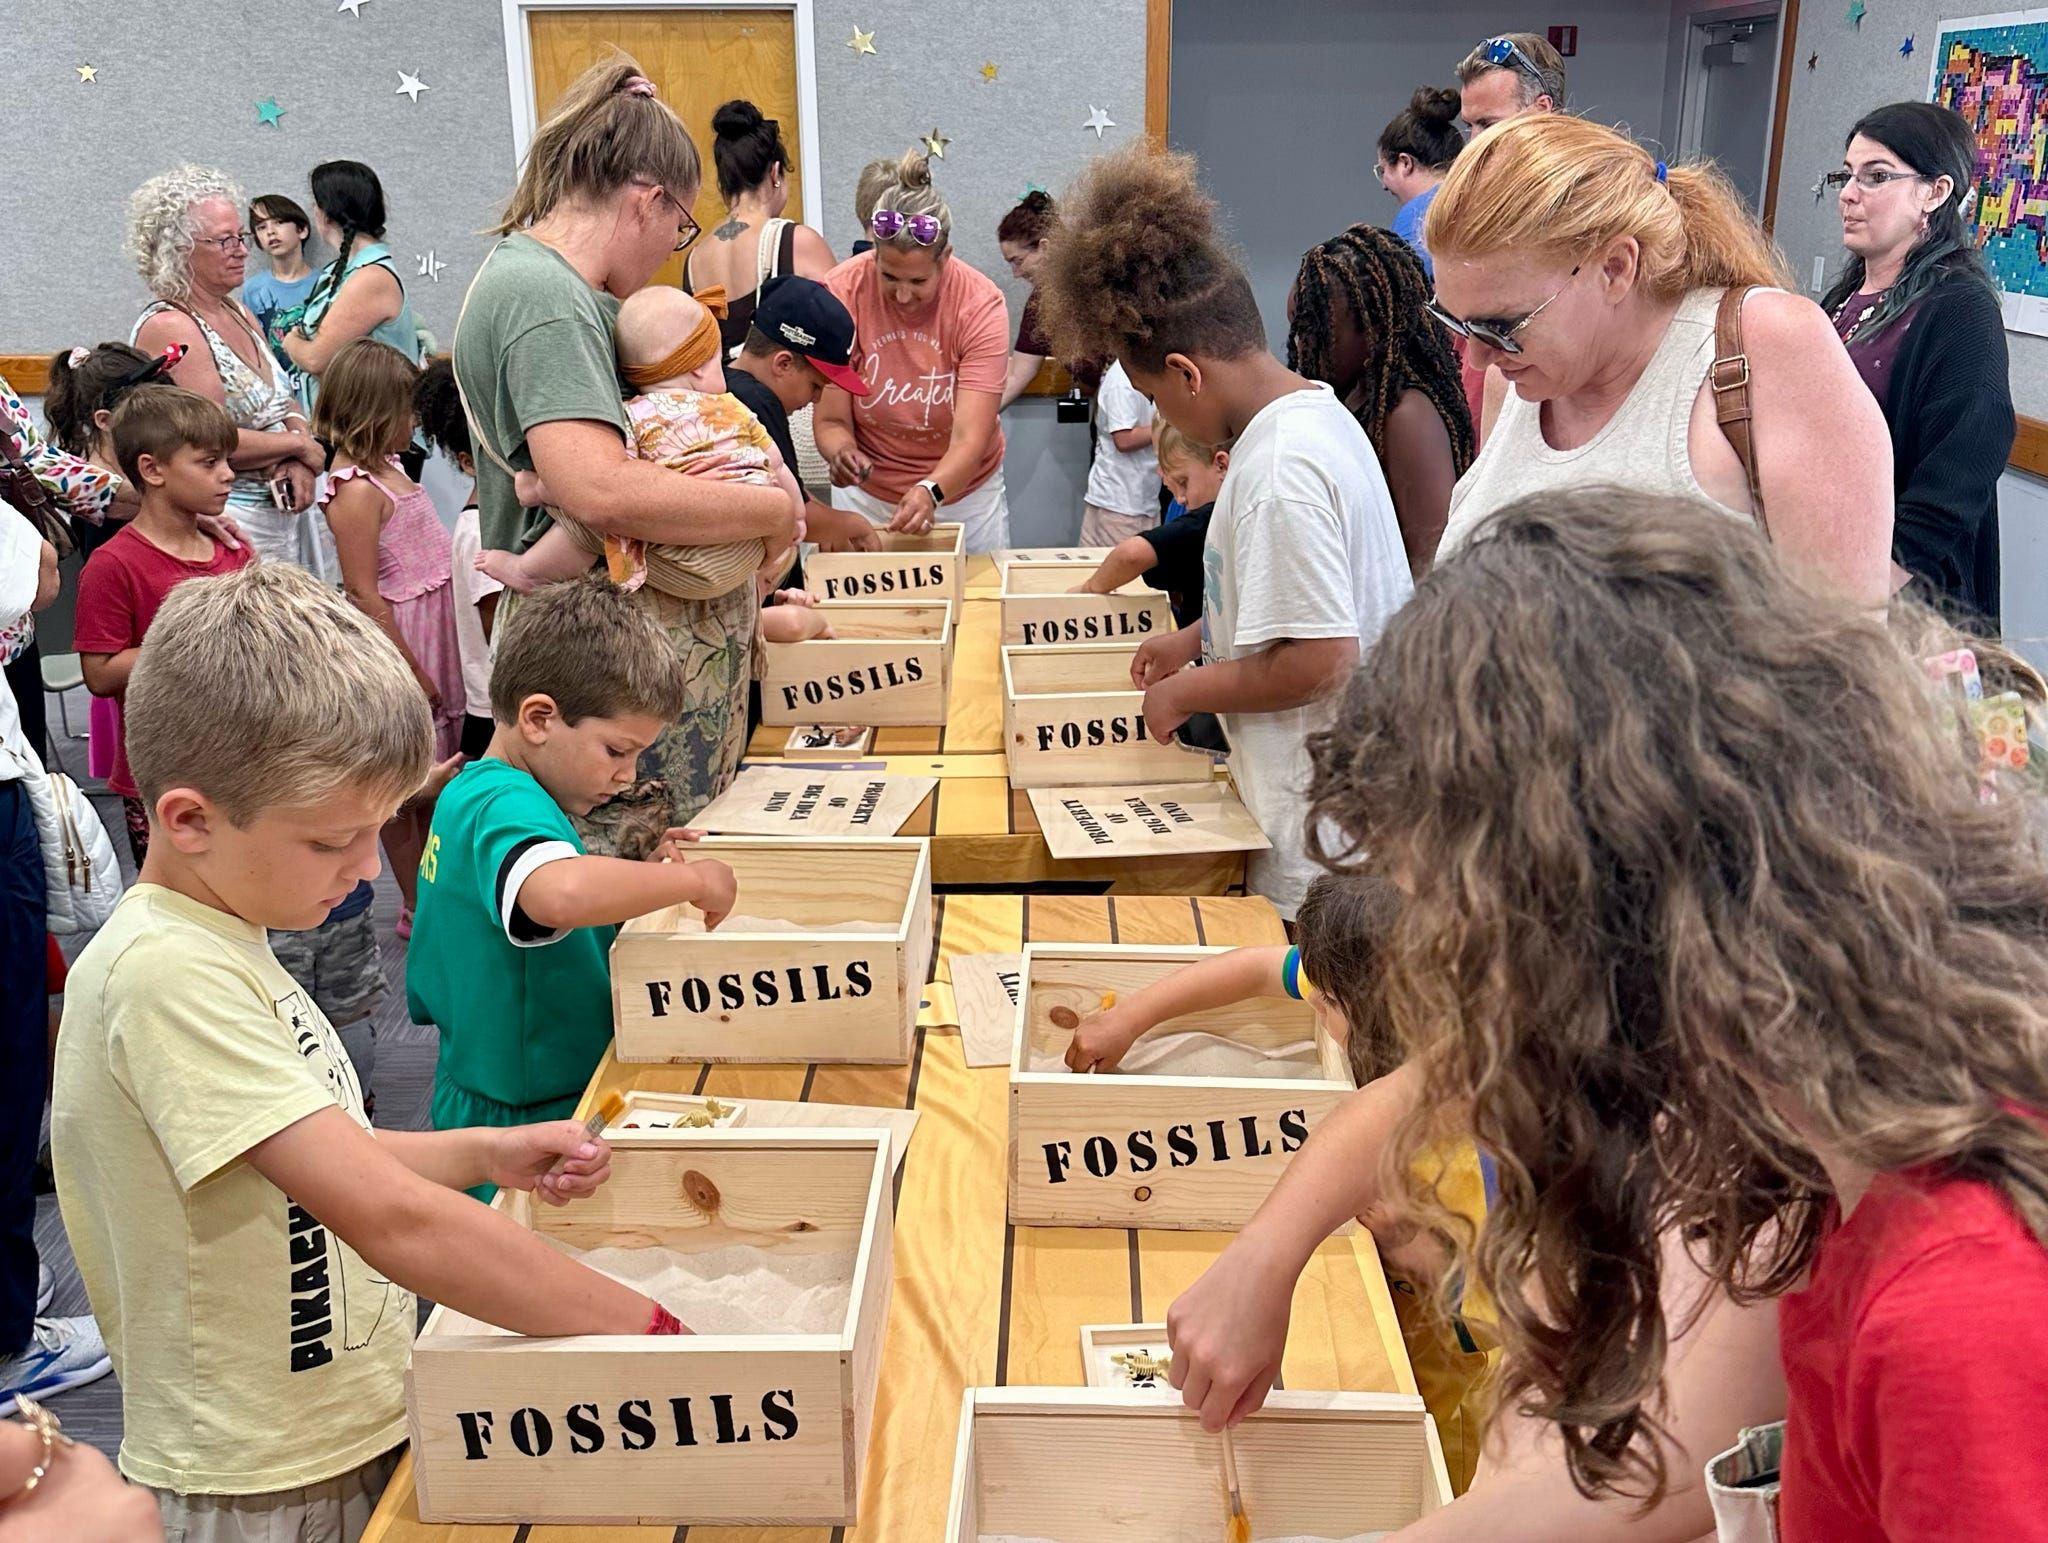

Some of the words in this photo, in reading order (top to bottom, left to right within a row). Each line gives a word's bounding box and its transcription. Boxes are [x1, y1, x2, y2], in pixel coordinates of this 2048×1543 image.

[860, 353, 956, 426] Created
[825, 564, 944, 599] FOSSILS
[1022, 610, 1153, 646] FOSSILS
[781, 656, 924, 712] FOSSILS
[1036, 714, 1148, 752] FOSSI
[763, 791, 792, 812] DINO
[801, 784, 826, 800] BIG
[828, 797, 849, 809] OF
[850, 782, 886, 825] PROPERTY
[1123, 797, 1156, 817] IDEA
[789, 800, 817, 821] IDEA
[1061, 799, 1114, 845] PROPERTY
[1104, 812, 1129, 824] OF
[1143, 818, 1172, 835] BIG
[1160, 801, 1194, 823] DINO
[645, 960, 873, 1017] FOSSILS
[1041, 1109, 1309, 1184] FOSSILS
[455, 1389, 800, 1461] FOSSILS
